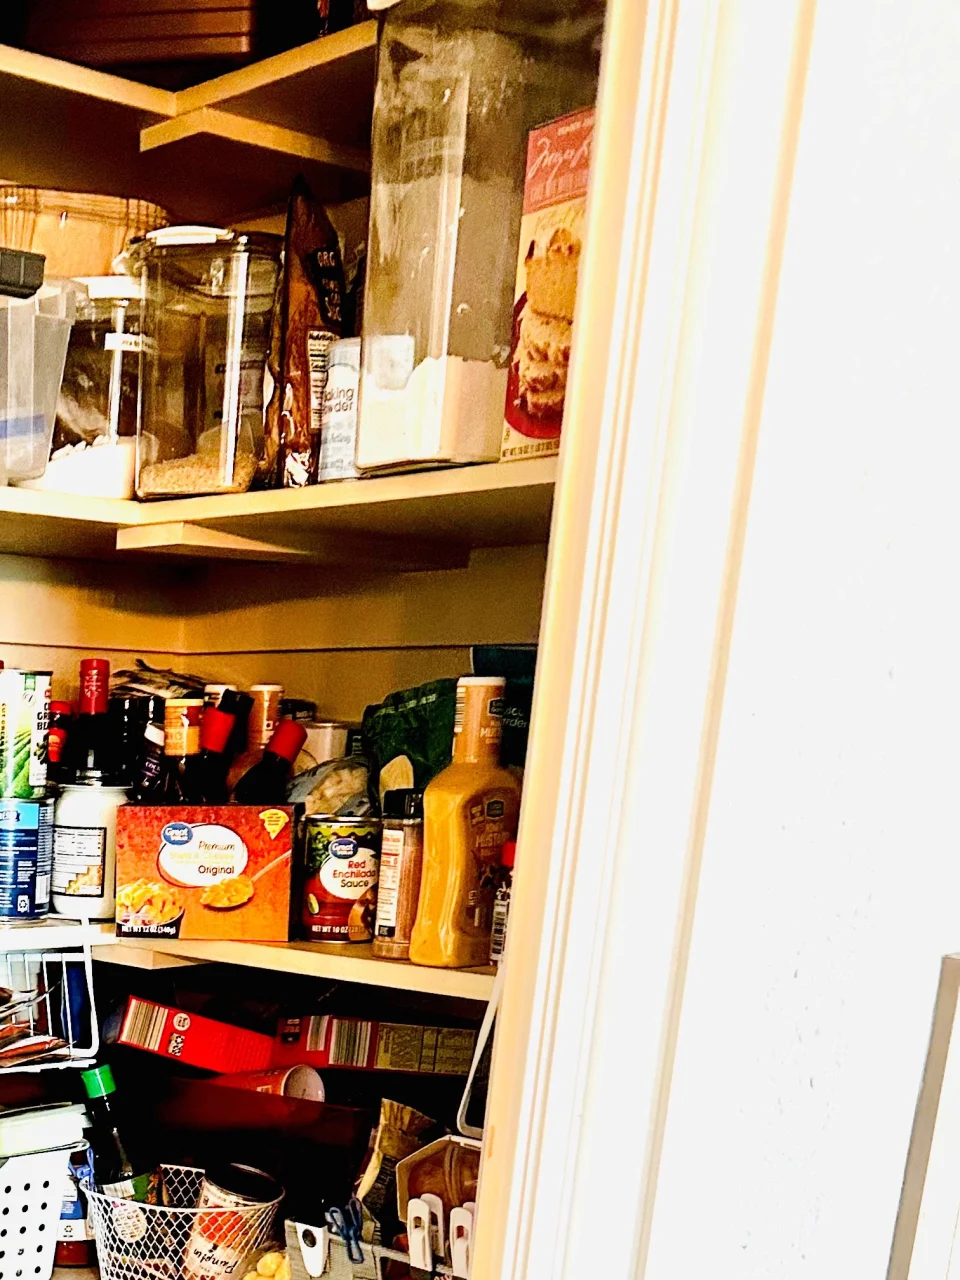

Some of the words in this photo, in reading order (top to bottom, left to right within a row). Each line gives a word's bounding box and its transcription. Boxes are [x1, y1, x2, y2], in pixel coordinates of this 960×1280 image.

[198, 840, 235, 852] Premium
[198, 864, 235, 877] Original
[347, 860, 366, 870] Red
[332, 868, 376, 879] Enchilada
[340, 879, 369, 889] Sauce
